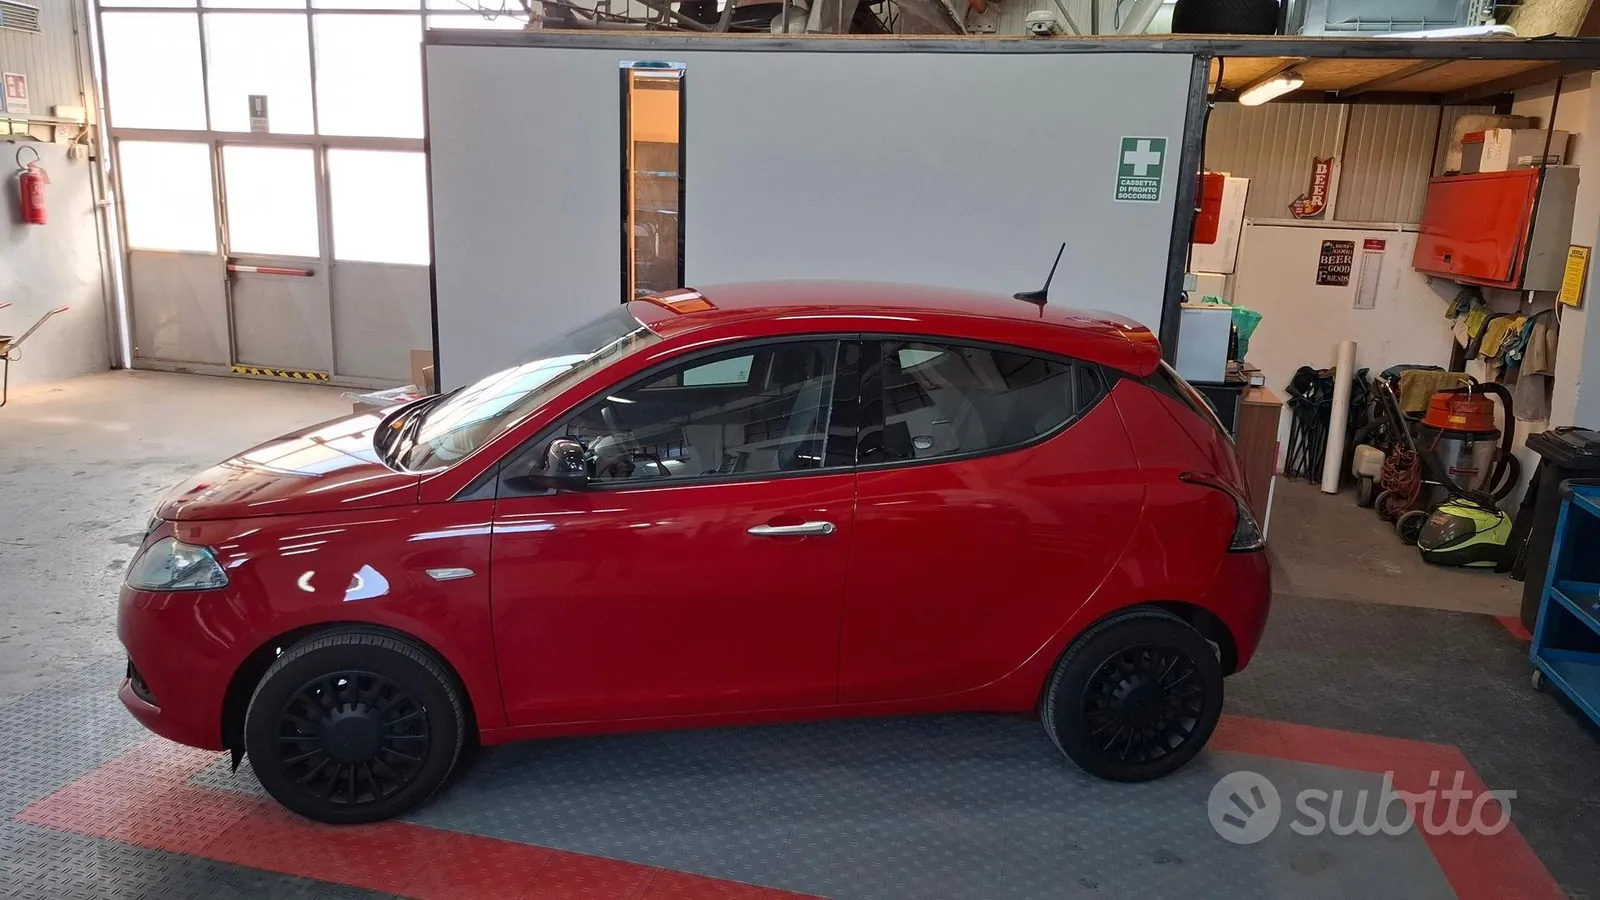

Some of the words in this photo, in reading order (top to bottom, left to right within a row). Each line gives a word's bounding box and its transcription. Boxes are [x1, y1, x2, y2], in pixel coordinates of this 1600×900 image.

[1311, 163, 1327, 206] BEER
[1320, 255, 1352, 264] BEER
[1327, 265, 1350, 273] GOOD
[1318, 270, 1349, 282] FRIENDS
